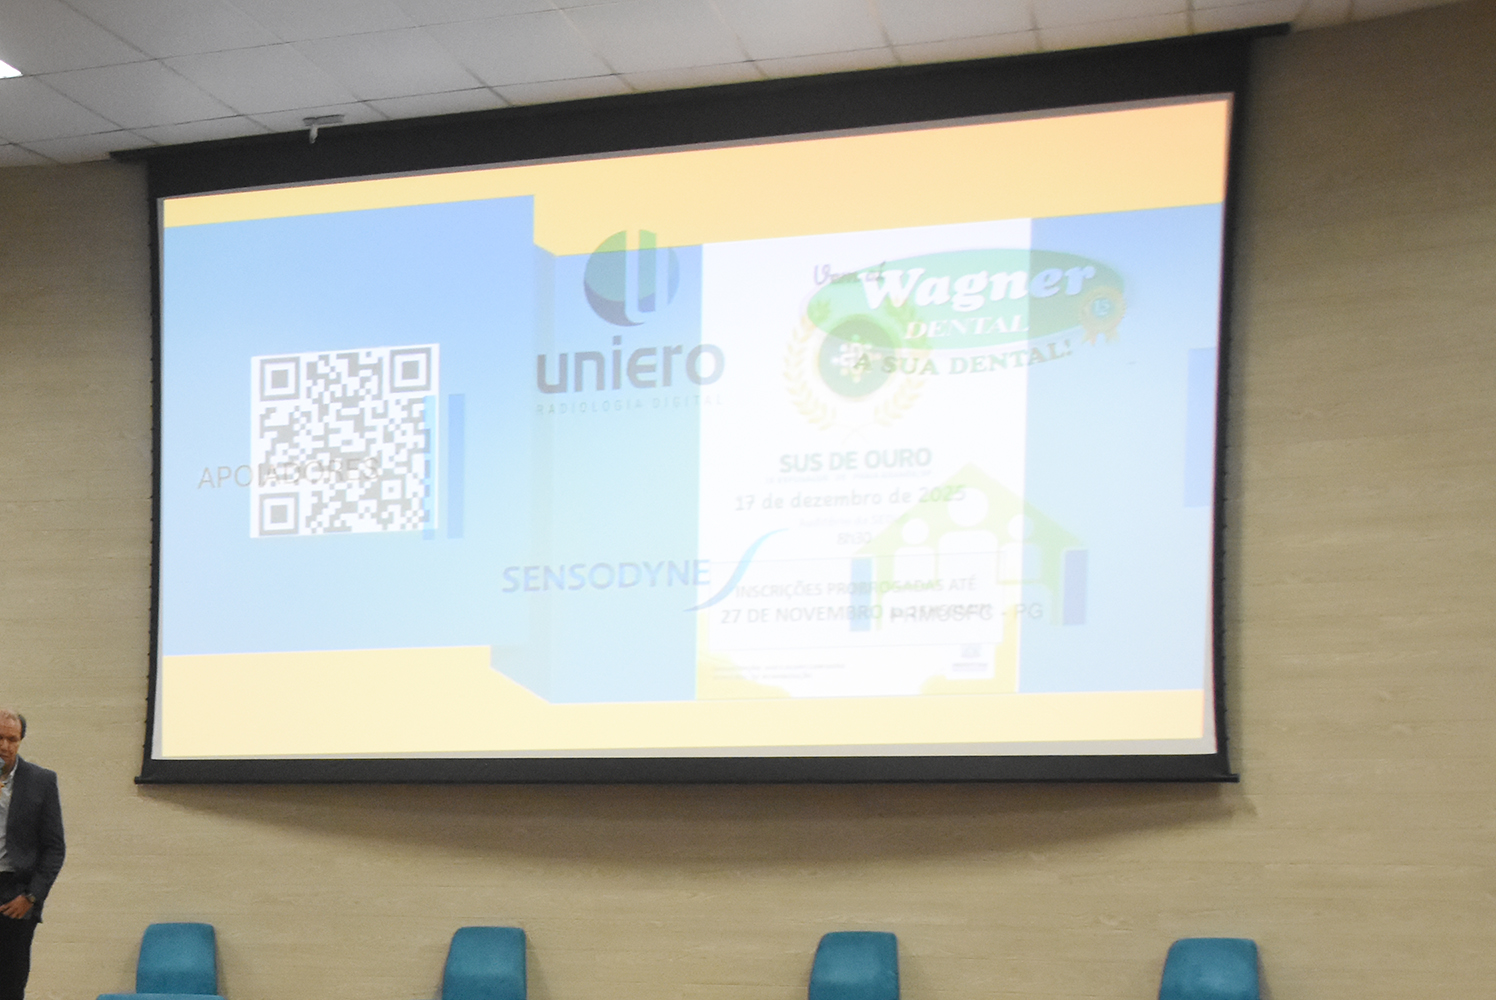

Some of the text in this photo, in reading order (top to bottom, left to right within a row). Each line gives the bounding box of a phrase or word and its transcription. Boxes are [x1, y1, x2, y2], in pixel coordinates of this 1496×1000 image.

[857, 265, 1096, 313] Wagner
[903, 314, 1030, 340] DENTAL
[536, 335, 726, 394] uniero
[853, 339, 1075, 376] A SUA DENTAL!
[536, 394, 723, 415] RADIOLOGIA DIGITAL
[197, 457, 381, 489] APOIADORES
[779, 447, 933, 474] SUS DE OURO
[735, 494, 755, 511] 17
[762, 492, 784, 510] de
[790, 489, 883, 509] dezembro
[889, 487, 912, 505] de
[837, 531, 872, 545] 8h30
[501, 559, 711, 593] SENSODYNE
[735, 580, 823, 600] INSCRIÇÕES
[949, 574, 977, 592] ATÉ
[720, 604, 883, 625] 27 DE NOVEMBRO
[1015, 602, 1044, 620] PG
